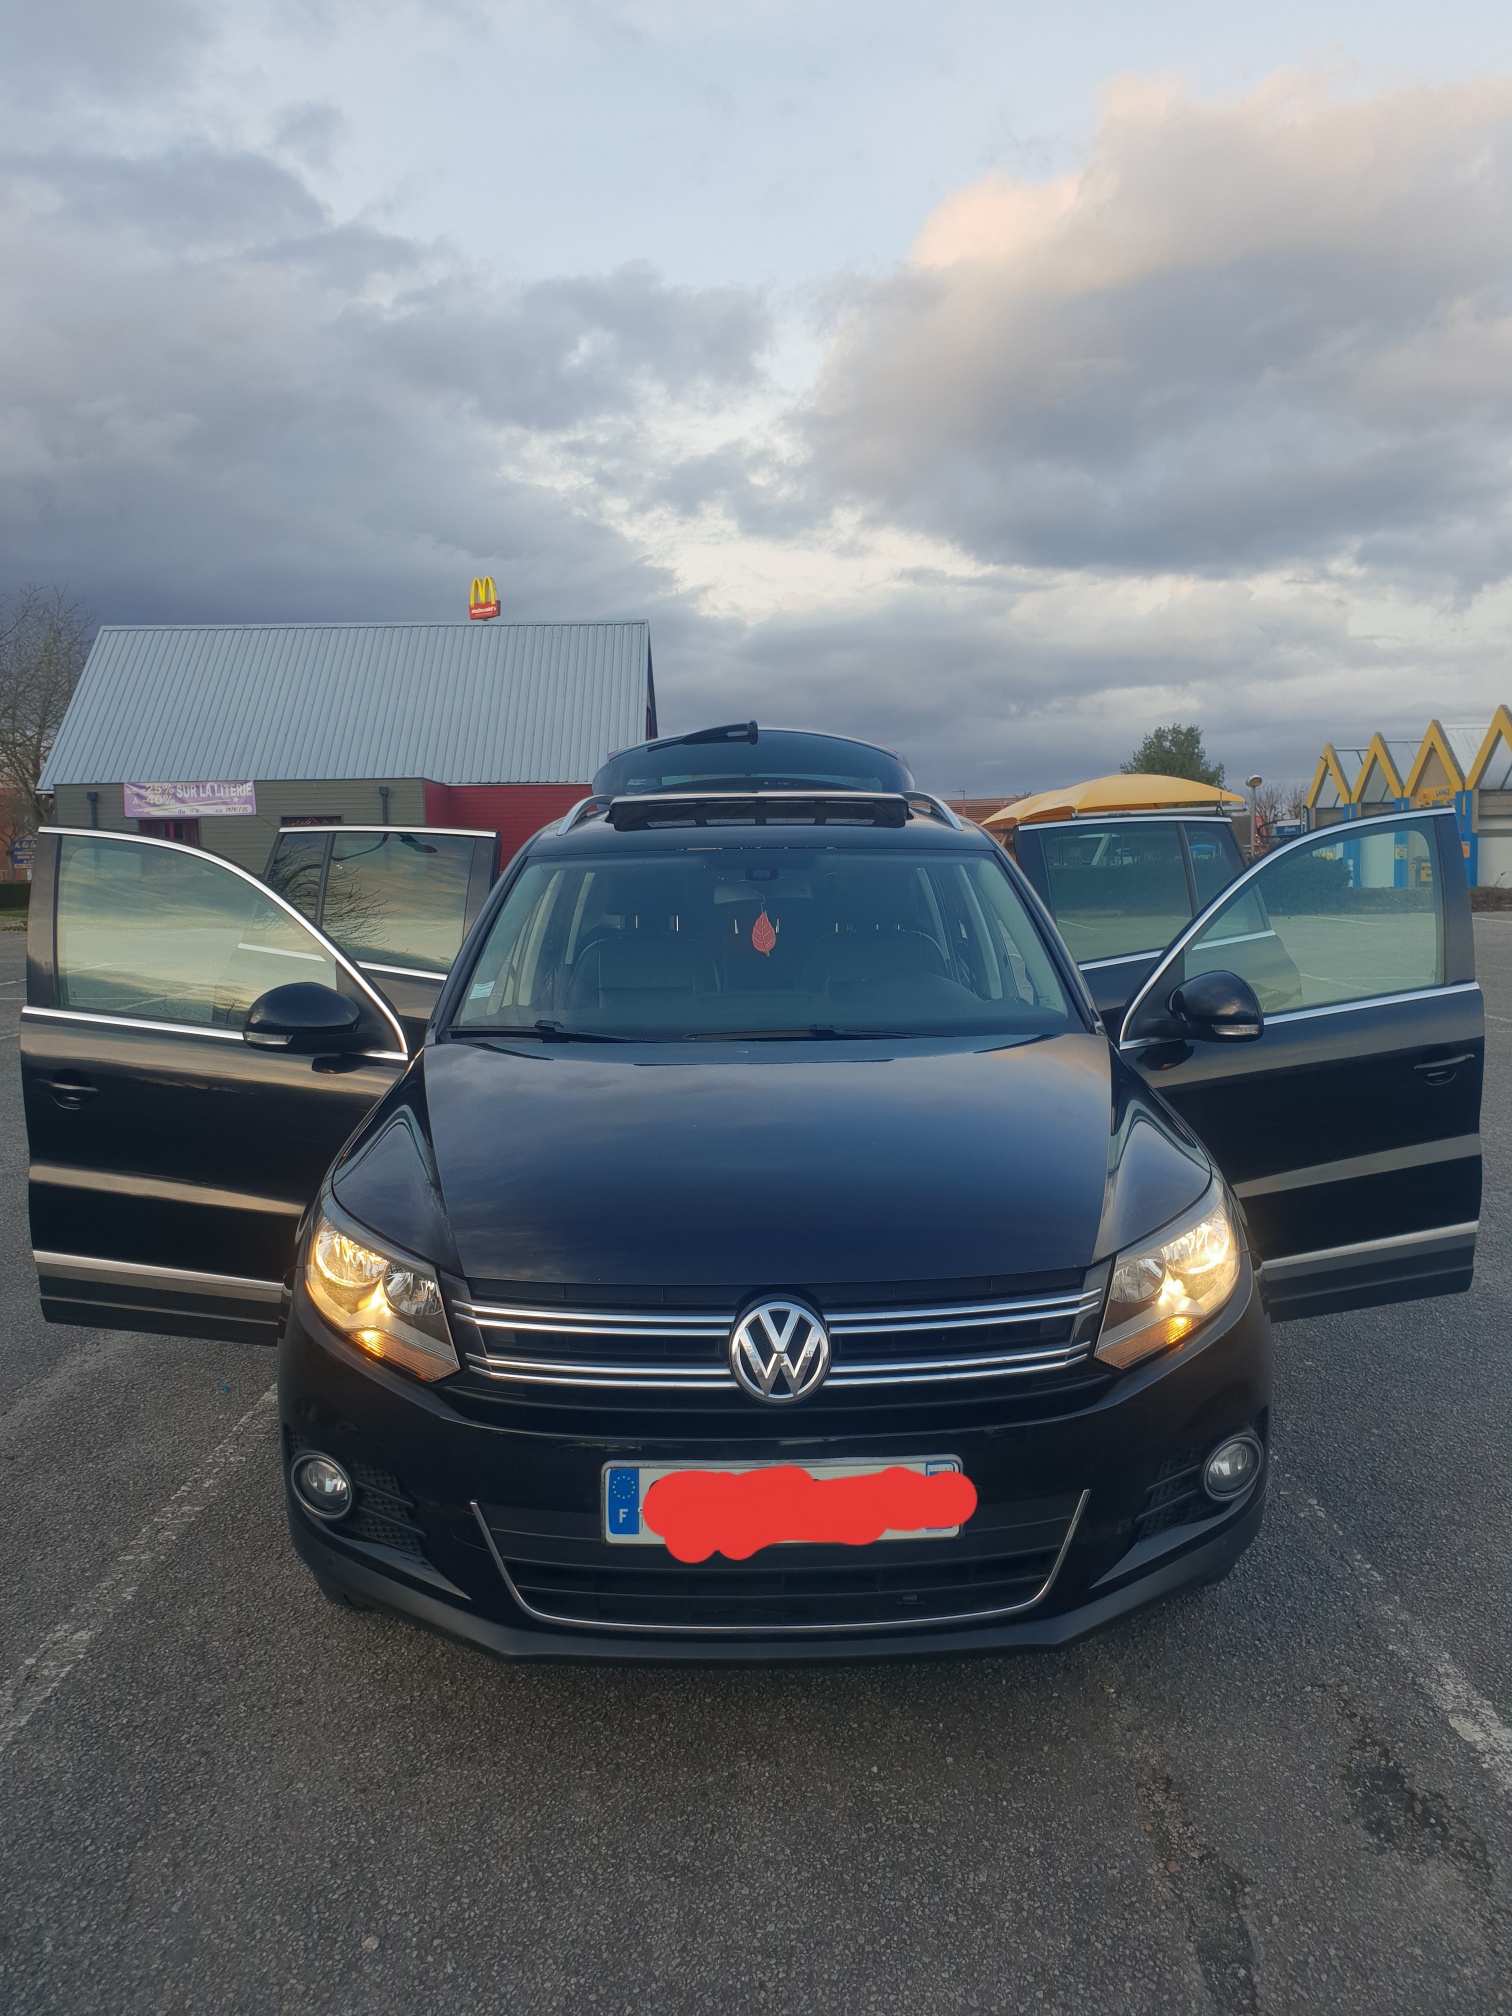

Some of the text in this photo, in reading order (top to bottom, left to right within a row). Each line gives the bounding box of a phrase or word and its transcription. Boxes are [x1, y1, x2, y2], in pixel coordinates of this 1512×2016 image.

[176, 782, 252, 798] SUR LA LITERIE
[619, 1508, 629, 1524] F
